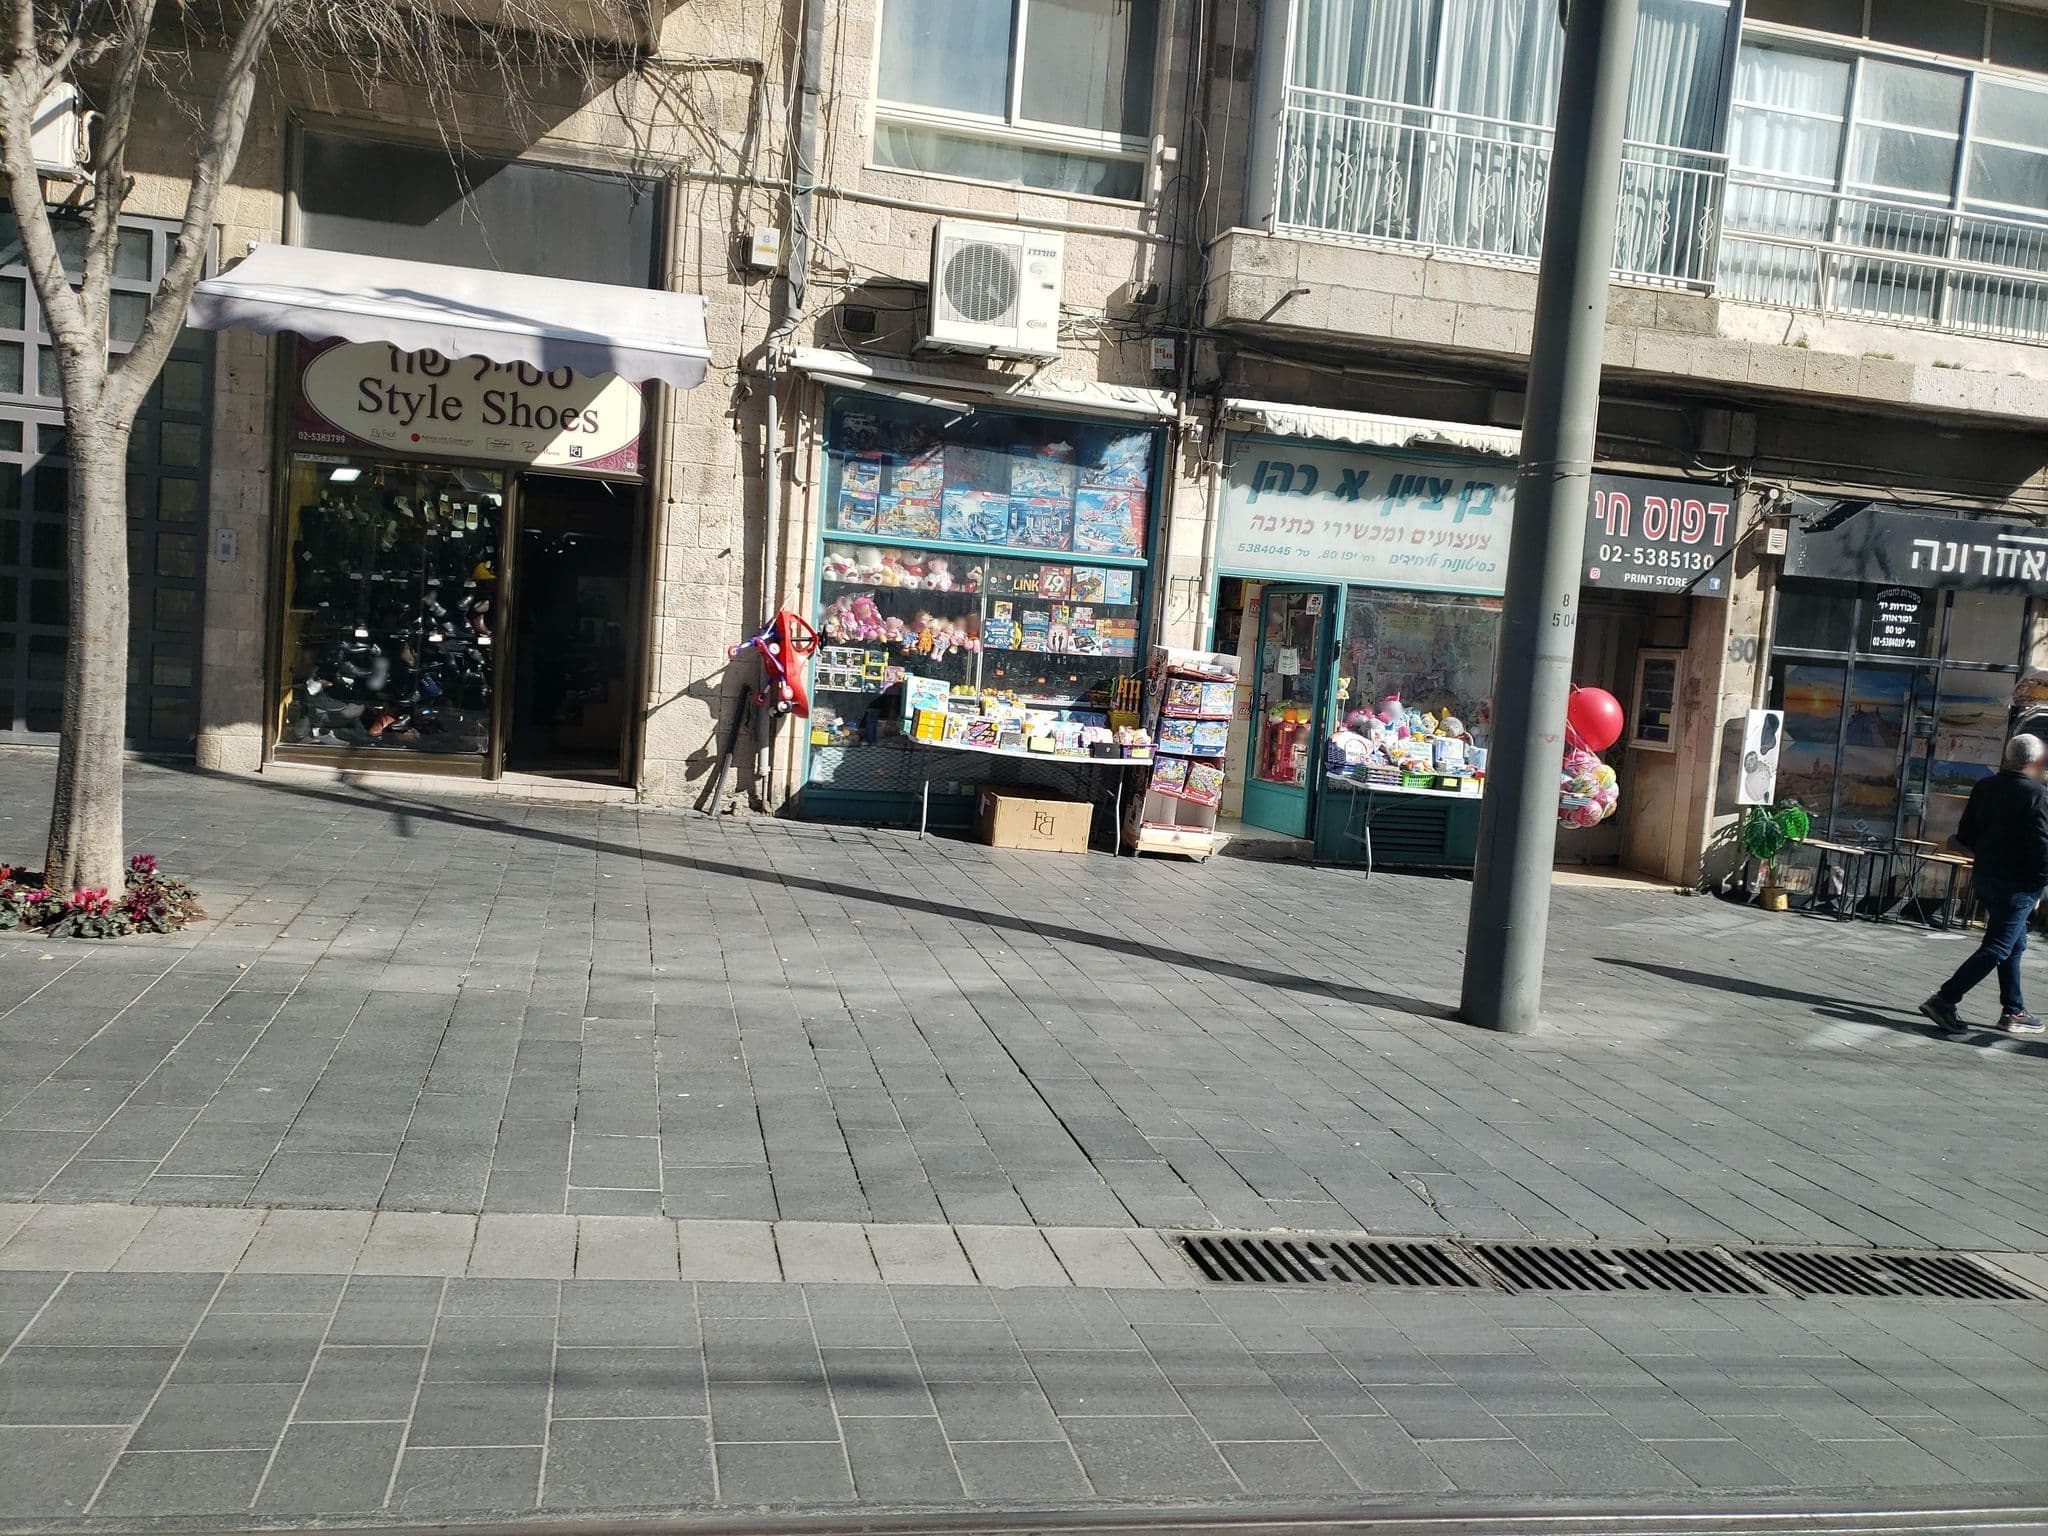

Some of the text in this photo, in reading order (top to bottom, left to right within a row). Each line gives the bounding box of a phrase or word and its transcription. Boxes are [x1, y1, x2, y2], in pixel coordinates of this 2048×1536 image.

[358, 377, 599, 434] Style Shoes
[298, 431, 346, 444] 02-5383799
[1246, 461, 1318, 504] כהן
[1380, 474, 1453, 516] ציון
[1453, 481, 1495, 523] בן
[1595, 490, 1730, 546] דפוס חי
[1250, 515, 1491, 550] צעצועים ומכשירי כתיבה
[1238, 543, 1292, 555] 5384045
[1599, 544, 1715, 570] 02-5385130
[1012, 577, 1039, 592] LINK
[1624, 573, 1688, 588] PRINT STORE
[1563, 593, 1570, 607] 8
[1889, 603, 1917, 612] עבודות
[1881, 613, 1912, 623] ומראות
[1885, 625, 1905, 634] יפו 80
[1730, 638, 1757, 663] 80
